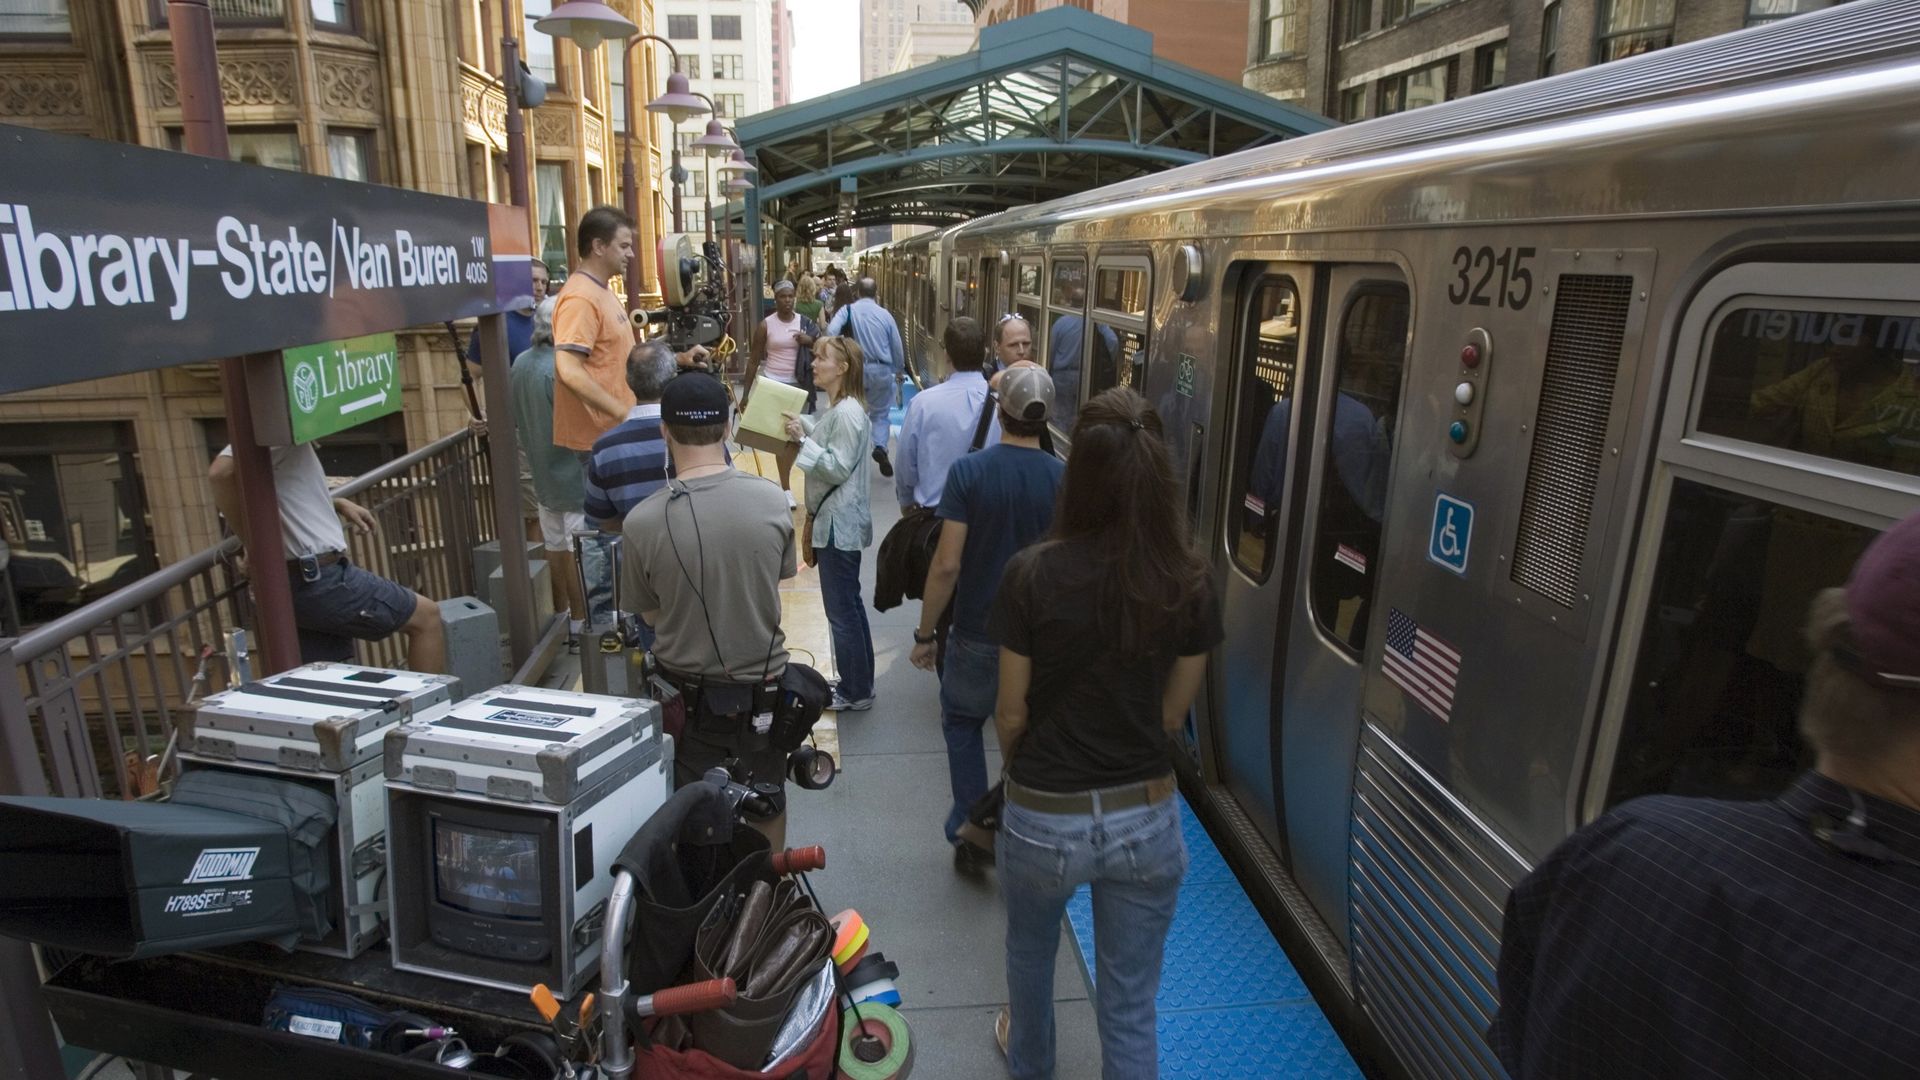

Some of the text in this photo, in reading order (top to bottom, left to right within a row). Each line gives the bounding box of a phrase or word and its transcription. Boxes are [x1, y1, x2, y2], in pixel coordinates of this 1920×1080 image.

[0, 203, 460, 321] ibrary-State/Van Buren
[470, 236, 485, 258] 1W
[465, 262, 488, 284] 400S
[1448, 246, 1536, 311] 3215
[317, 348, 393, 398] Library
[183, 847, 261, 884] HOODMAN
